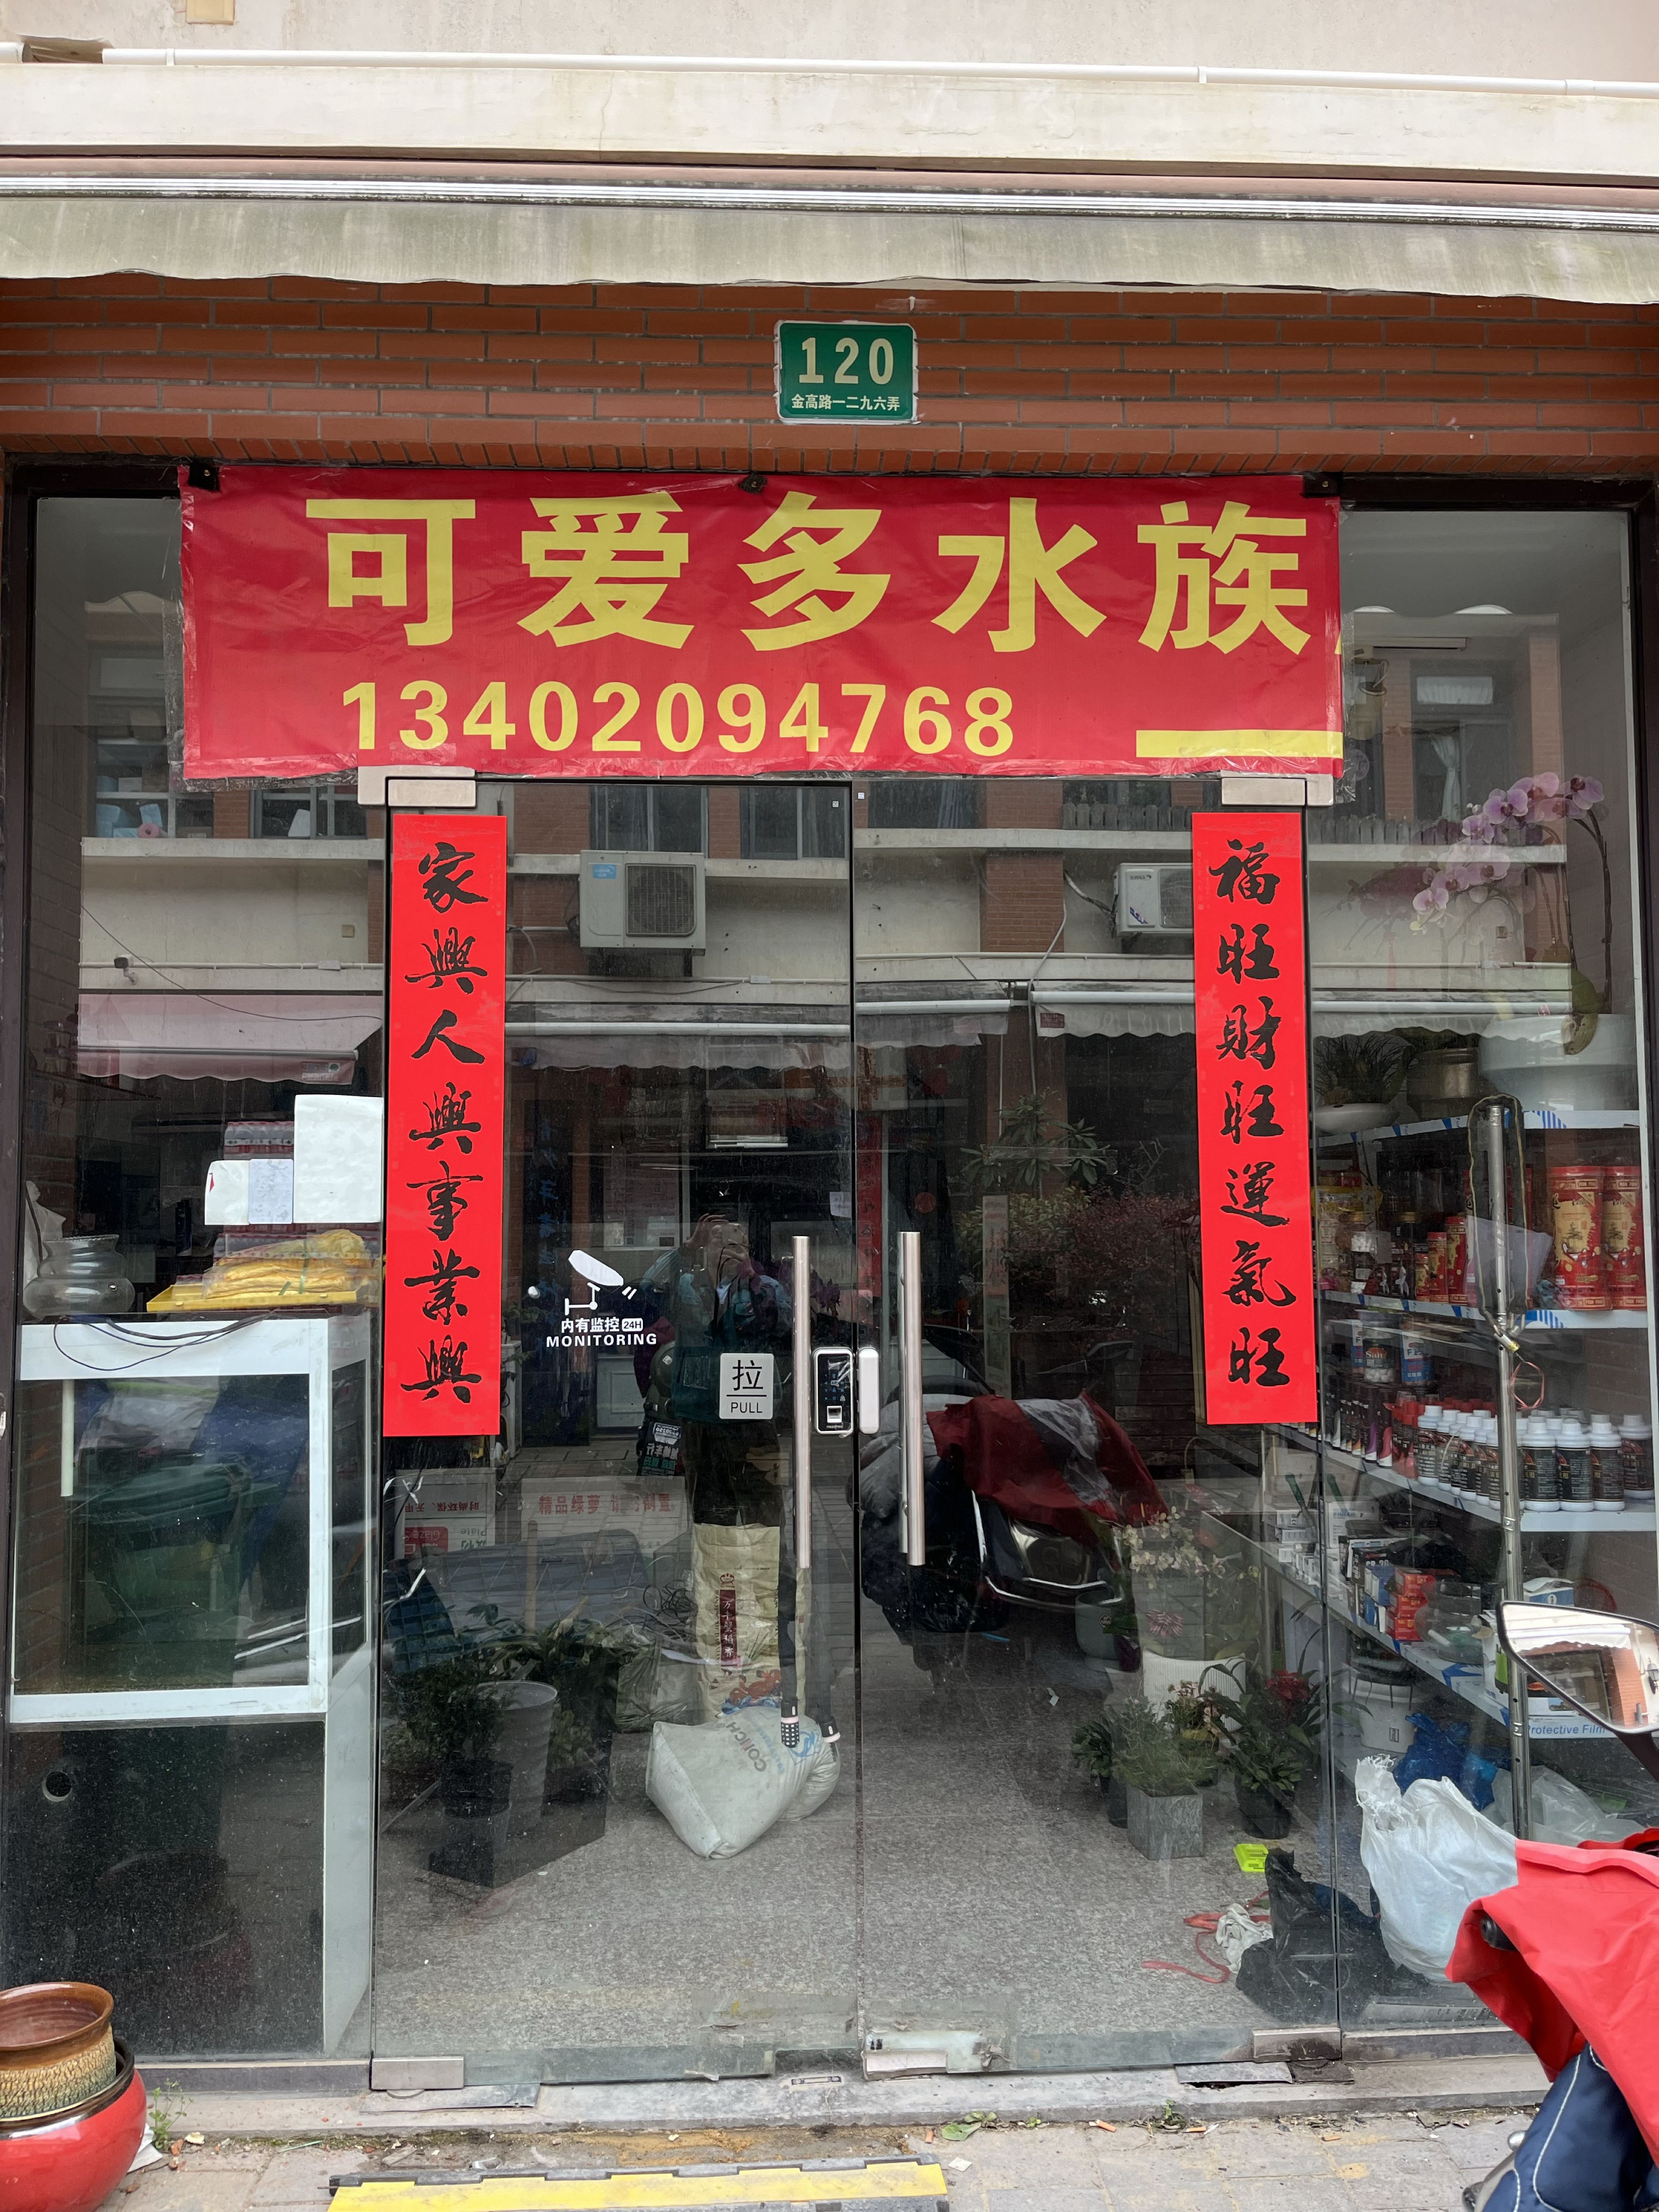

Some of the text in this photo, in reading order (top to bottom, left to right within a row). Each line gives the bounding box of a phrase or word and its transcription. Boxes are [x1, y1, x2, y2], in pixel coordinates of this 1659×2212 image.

[799, 337, 894, 384] 120
[791, 394, 900, 411] 金高路一二九六弄
[306, 491, 1311, 655] 可爱多水族
[343, 680, 1014, 757] 13402094768
[400, 842, 488, 1403] 家興人興事業興
[1208, 839, 1296, 1387] 福旺財旺運氣旺
[561, 1317, 642, 1333] 内有监控 24H
[547, 1333, 657, 1347] MONITORING
[732, 1359, 764, 1391] 拉
[731, 1402, 763, 1413] PULL
[413, 1530, 440, 1541] Glaze
[1528, 1724, 1605, 1734] rotective Film
